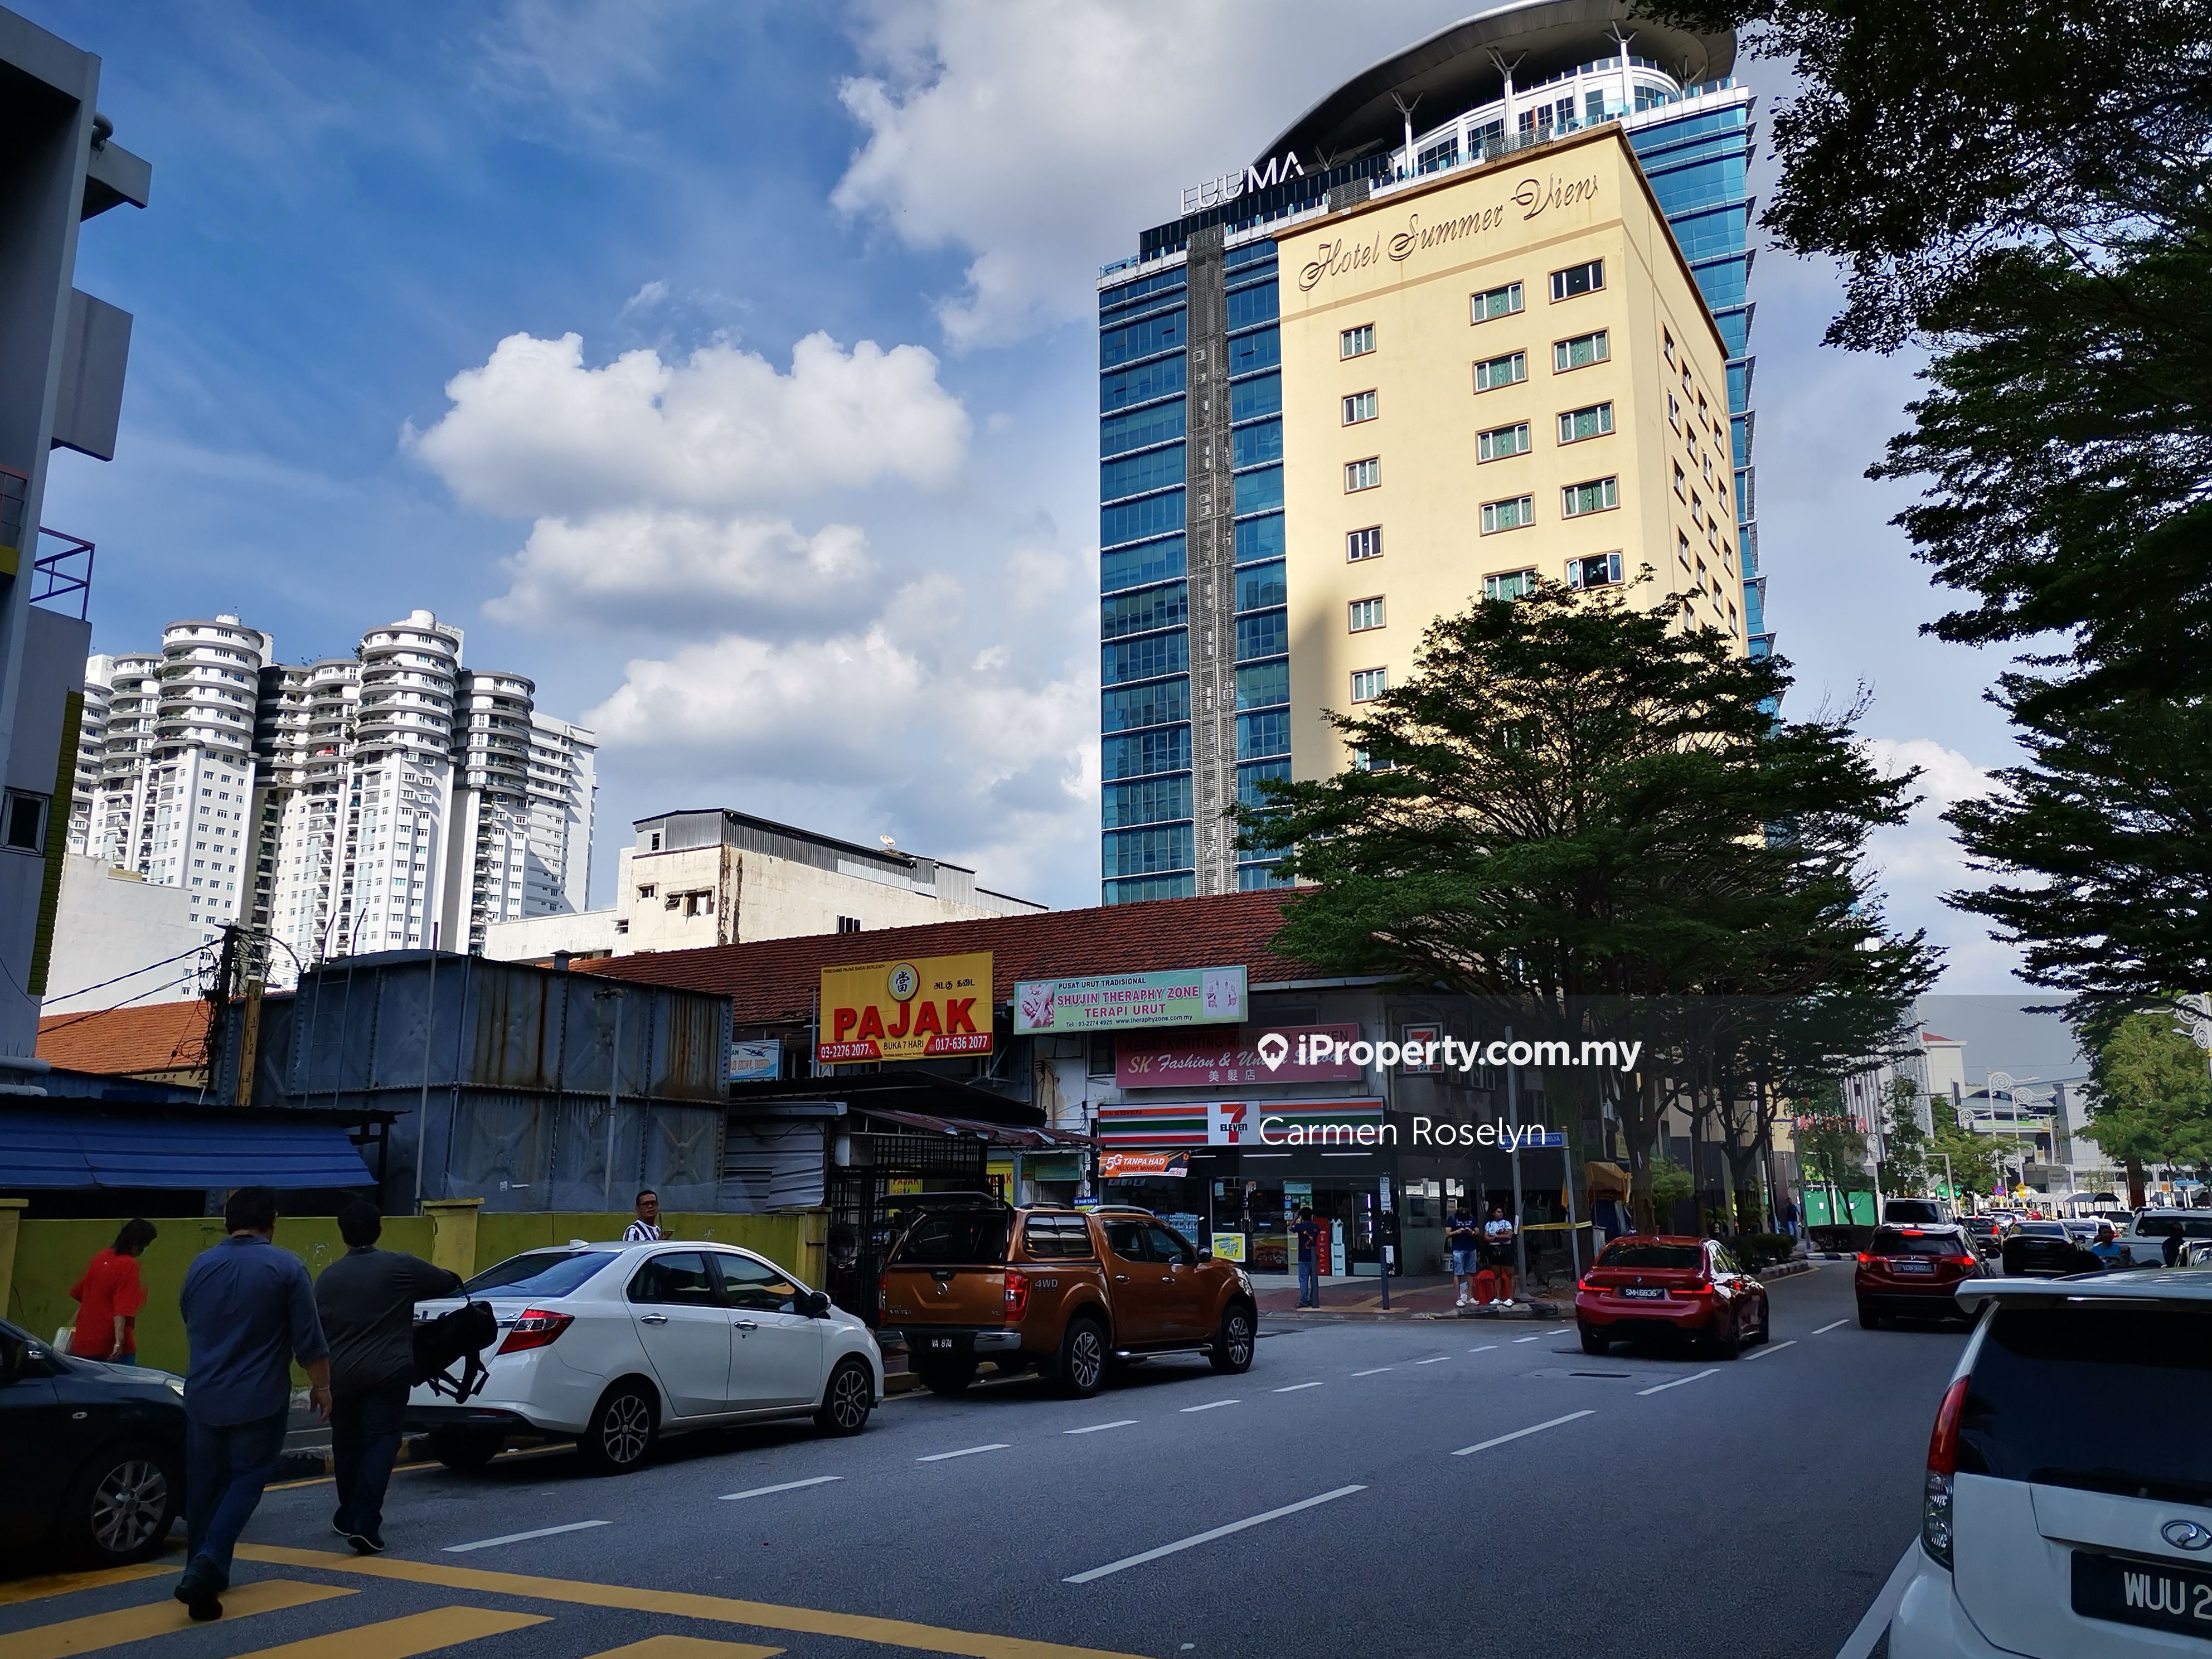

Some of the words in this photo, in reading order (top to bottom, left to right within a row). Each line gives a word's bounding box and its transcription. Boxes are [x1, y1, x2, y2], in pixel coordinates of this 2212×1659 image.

[1299, 230, 1381, 292] Hotel
[1388, 202, 1503, 261] Summer
[1102, 977, 1146, 987] TRADISIONAL
[1057, 991, 1099, 1006] SHUJIN
[1103, 988, 1163, 1004] THERAPHY
[1167, 985, 1200, 999] ZONE
[1085, 1005, 1127, 1018] TERAPI
[1133, 1003, 1167, 1015] URUT
[834, 998, 977, 1041] PAJAK
[821, 1044, 850, 1058] 03-2276
[852, 1043, 869, 1056] 2077
[884, 1041, 902, 1050] BUKA
[908, 1040, 924, 1049] HARI
[935, 1037, 967, 1051] 017-636
[969, 1035, 988, 1049] 2077
[1128, 1055, 1153, 1073] SK
[1158, 1052, 1215, 1073] Fashion
[1219, 1052, 1231, 1067] &
[1105, 1154, 1123, 1170] 5G
[1035, 1279, 1058, 1288] 4WD
[932, 1339, 939, 1348] VA
[941, 1338, 952, 1348] 874
[2124, 1571, 2185, 1614] WUU
